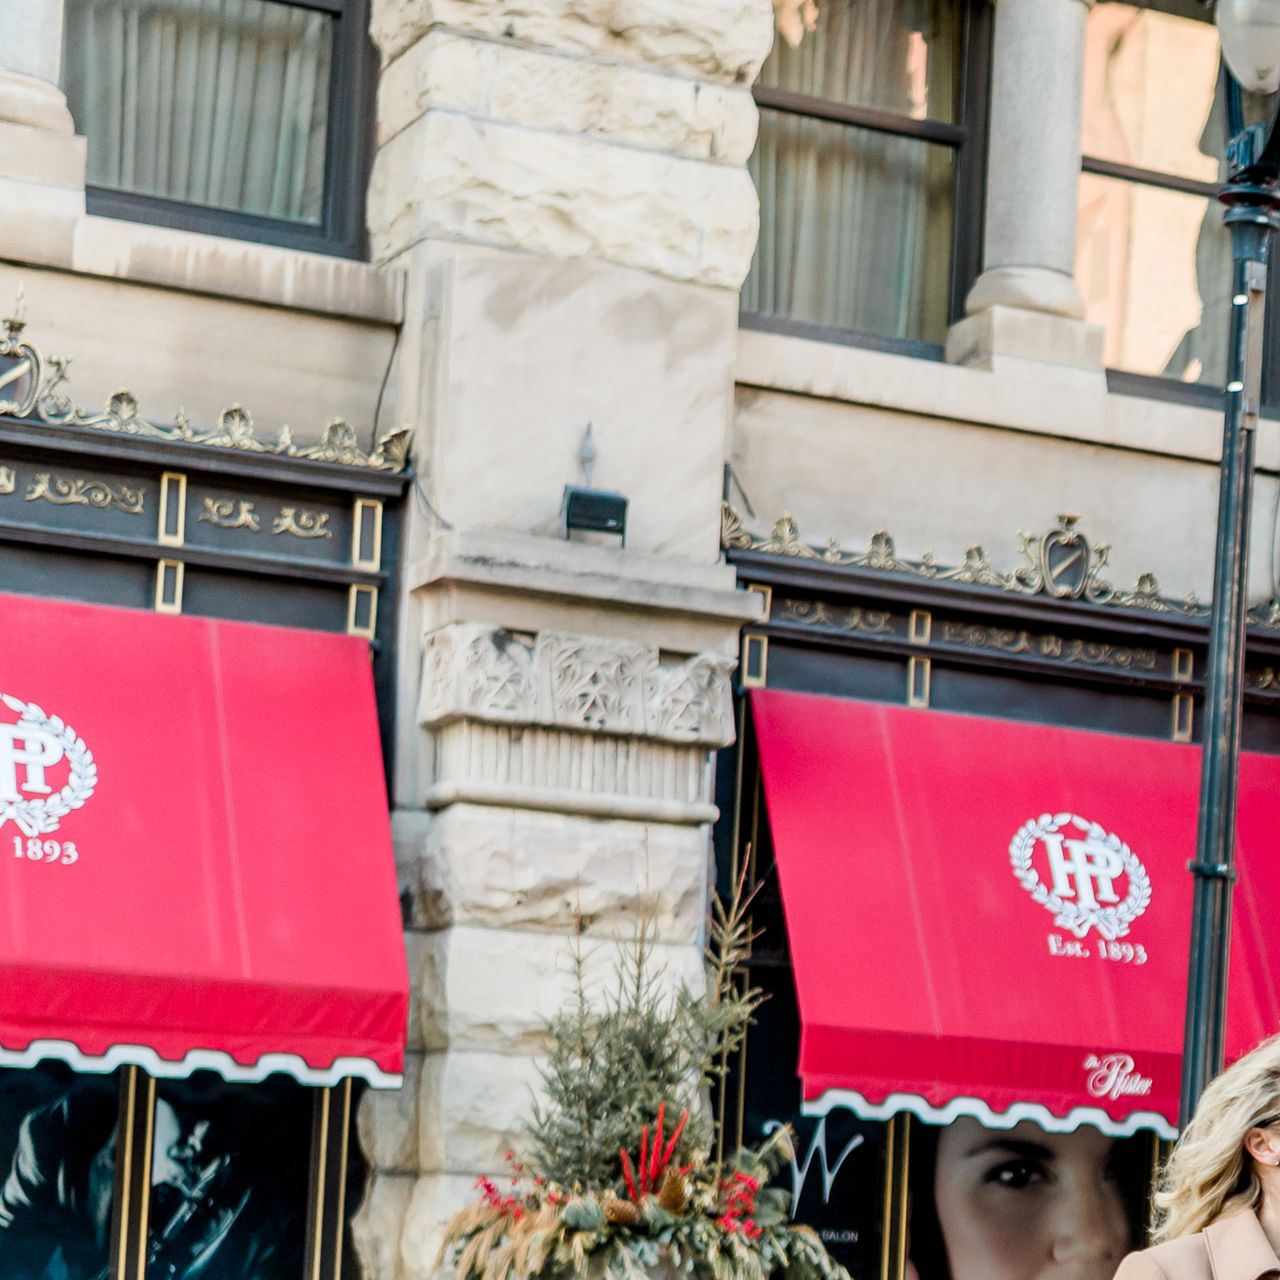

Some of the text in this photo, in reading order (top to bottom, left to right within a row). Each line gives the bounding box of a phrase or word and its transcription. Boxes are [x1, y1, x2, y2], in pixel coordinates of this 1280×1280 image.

[12, 835, 79, 865] 1893
[1047, 933, 1148, 966] Est. 1893
